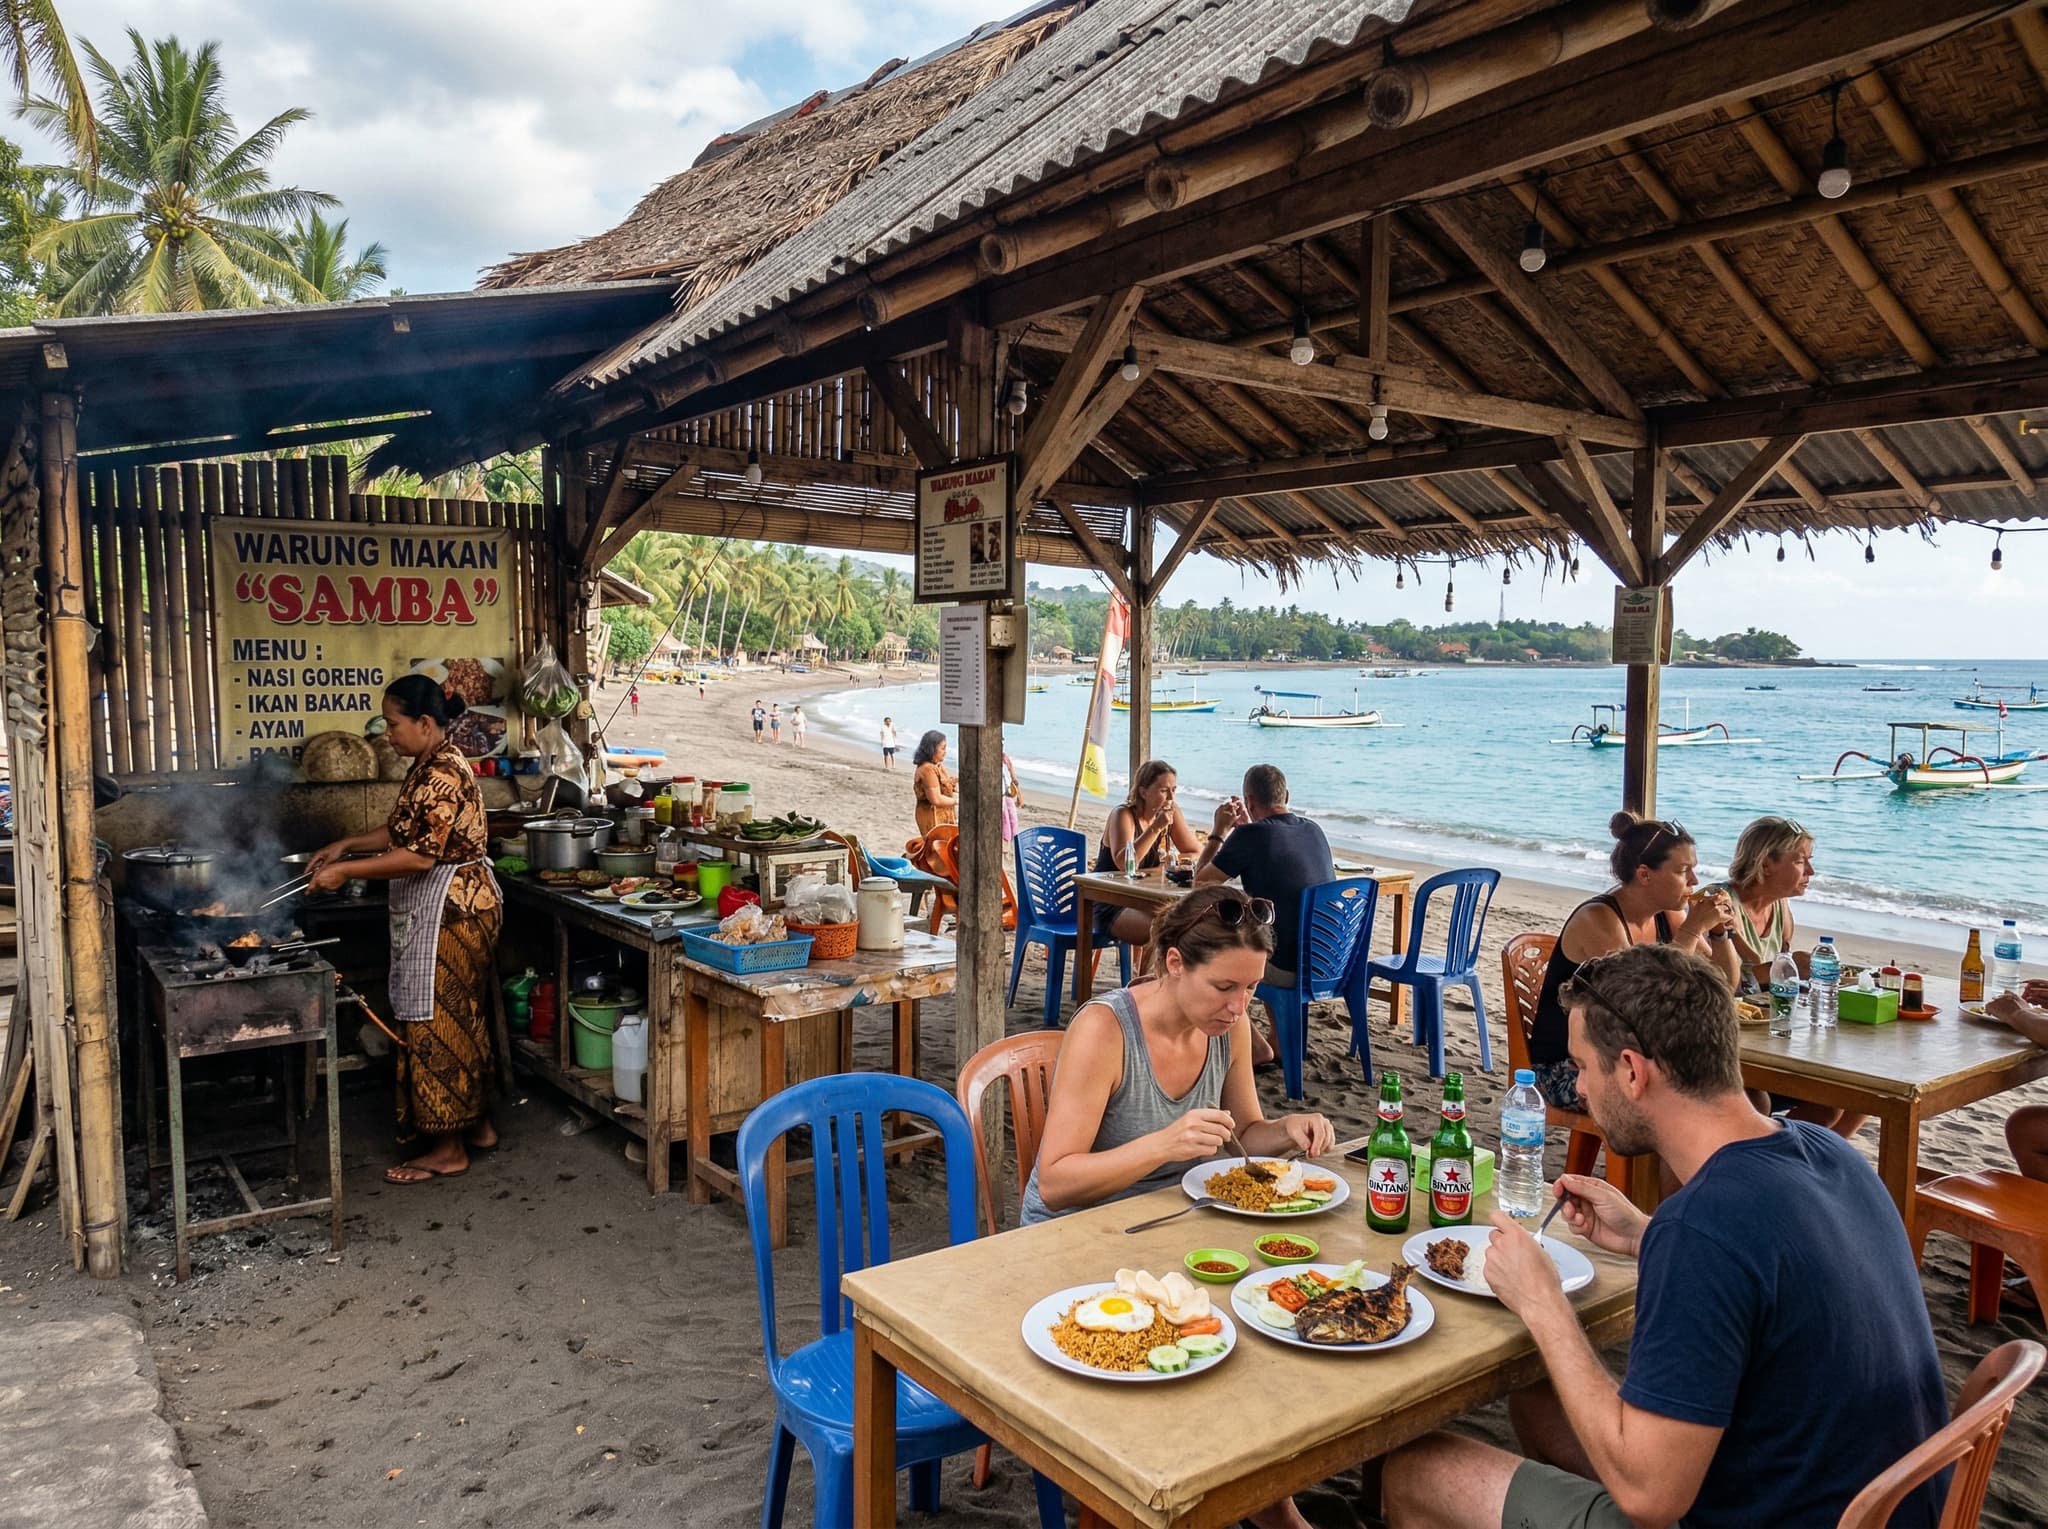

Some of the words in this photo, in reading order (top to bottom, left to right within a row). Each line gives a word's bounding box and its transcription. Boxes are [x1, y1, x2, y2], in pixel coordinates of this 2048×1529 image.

[234, 532, 379, 567] WARUNG
[391, 538, 498, 570] MAKAN
[232, 639, 307, 661] MENU
[248, 668, 296, 688] NASI
[302, 667, 384, 687] GORENG
[249, 694, 298, 713] IKAN
[304, 693, 372, 712] BAKAR
[249, 719, 304, 739] AYAM
